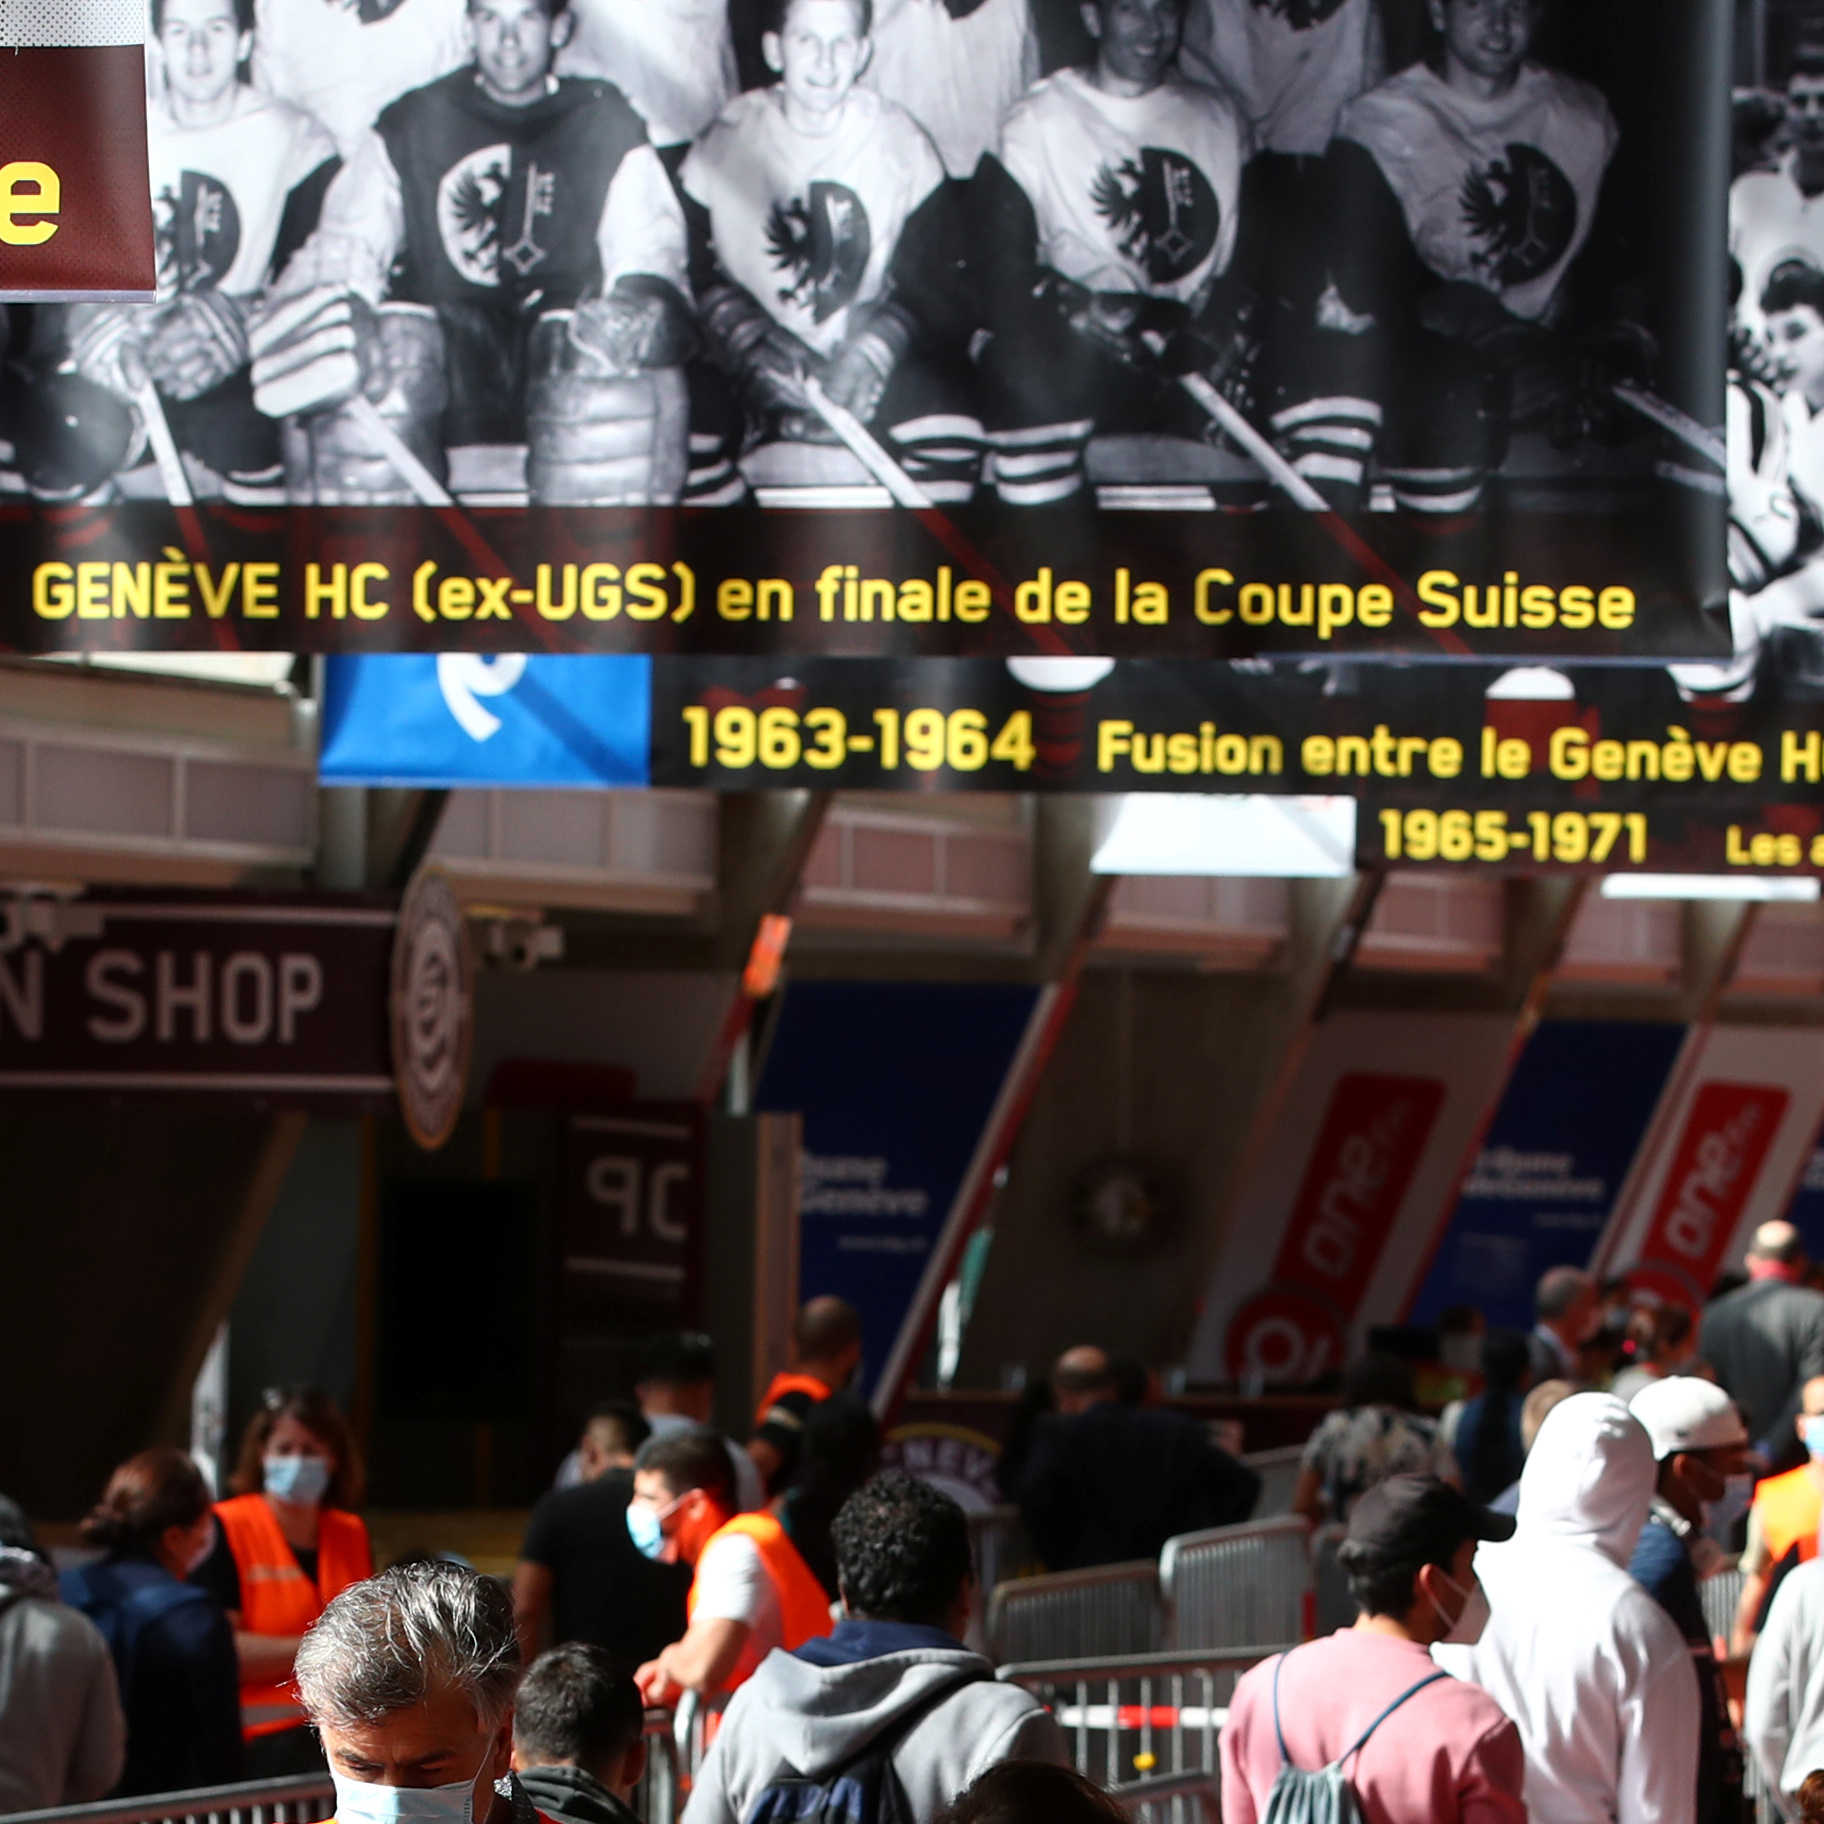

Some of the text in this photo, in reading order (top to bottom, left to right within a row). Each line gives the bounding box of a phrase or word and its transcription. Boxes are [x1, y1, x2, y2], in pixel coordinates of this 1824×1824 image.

[33, 547, 279, 619] GENÈVE
[305, 562, 390, 620] HC
[413, 561, 694, 622] (ex-UGS)
[718, 579, 793, 621] en
[815, 566, 991, 622] finale
[1015, 568, 1091, 624] de
[1115, 568, 1168, 624] la
[1195, 569, 1393, 639] Coupe
[1418, 570, 1635, 629] Suisse
[683, 706, 1035, 771] 1963-1964
[1098, 720, 1282, 774] Fusion
[1302, 727, 1462, 777] entre
[1481, 728, 1531, 778] le
[1549, 726, 1762, 782] Genève
[1379, 809, 1646, 863] 1965-1971
[1726, 825, 1802, 866] Les
[86, 951, 322, 1043] SHOP
